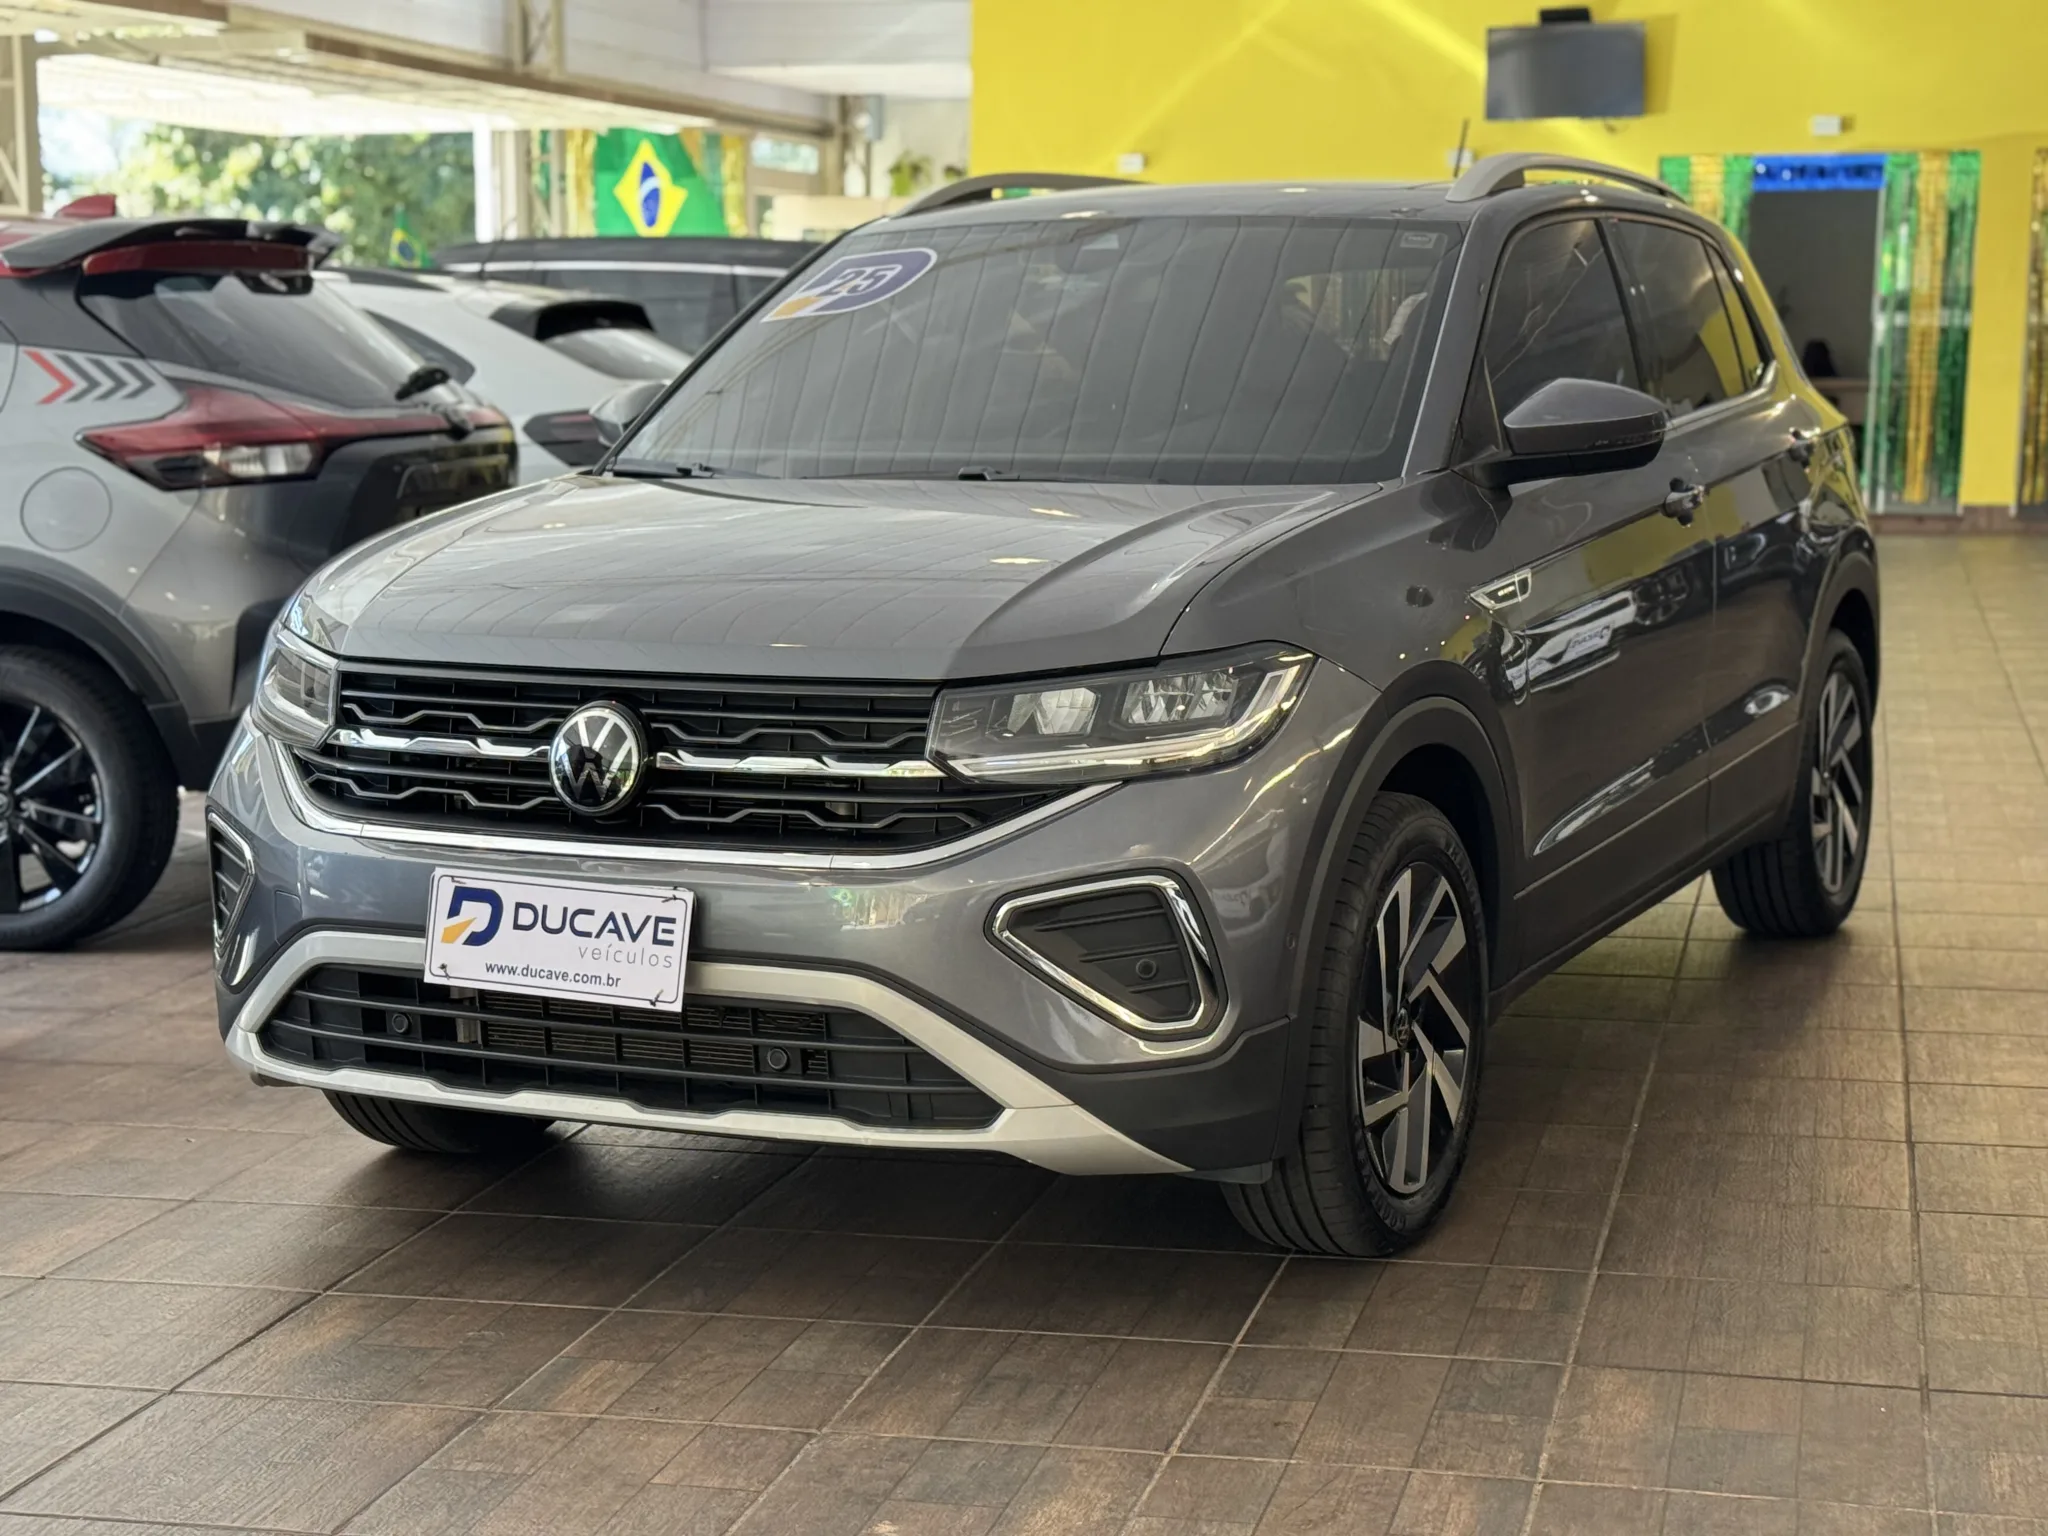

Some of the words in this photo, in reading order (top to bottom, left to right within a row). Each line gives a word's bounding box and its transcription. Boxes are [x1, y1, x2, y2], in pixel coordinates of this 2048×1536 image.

[818, 266, 898, 296] 25
[512, 901, 677, 947] DUCAVE
[577, 944, 673, 969] veículos
[485, 962, 622, 988] www.ducave.com.br
